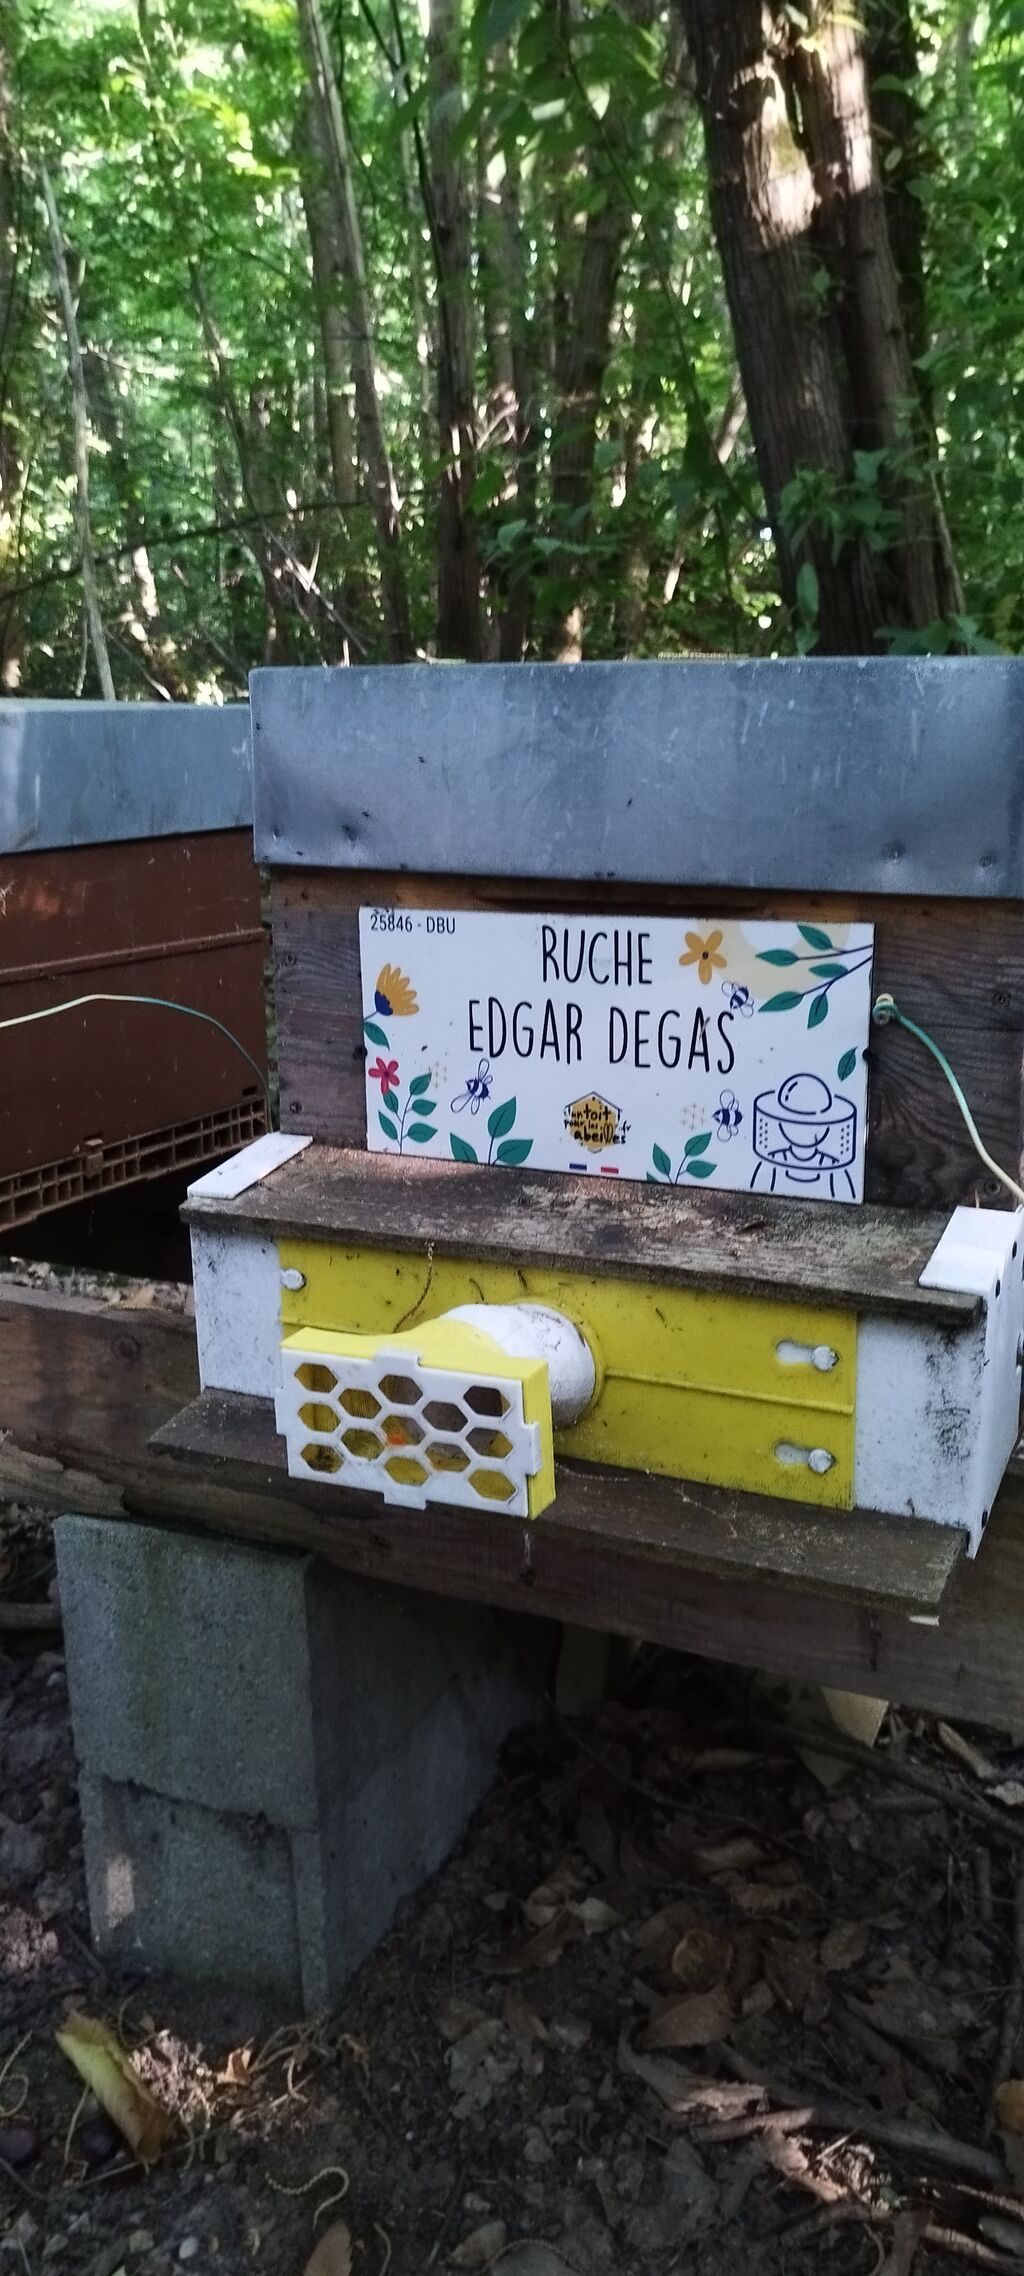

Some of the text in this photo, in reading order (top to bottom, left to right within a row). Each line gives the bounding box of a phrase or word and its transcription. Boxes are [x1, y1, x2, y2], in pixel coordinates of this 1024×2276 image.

[370, 914, 413, 932] 25846
[426, 916, 456, 934] DBU
[541, 925, 653, 986] RUCHE
[468, 996, 735, 1074] EDGAR DEGAS
[583, 1103, 612, 1121] toit
[564, 1119, 585, 1130] pour
[574, 1122, 627, 1145] abeilles
